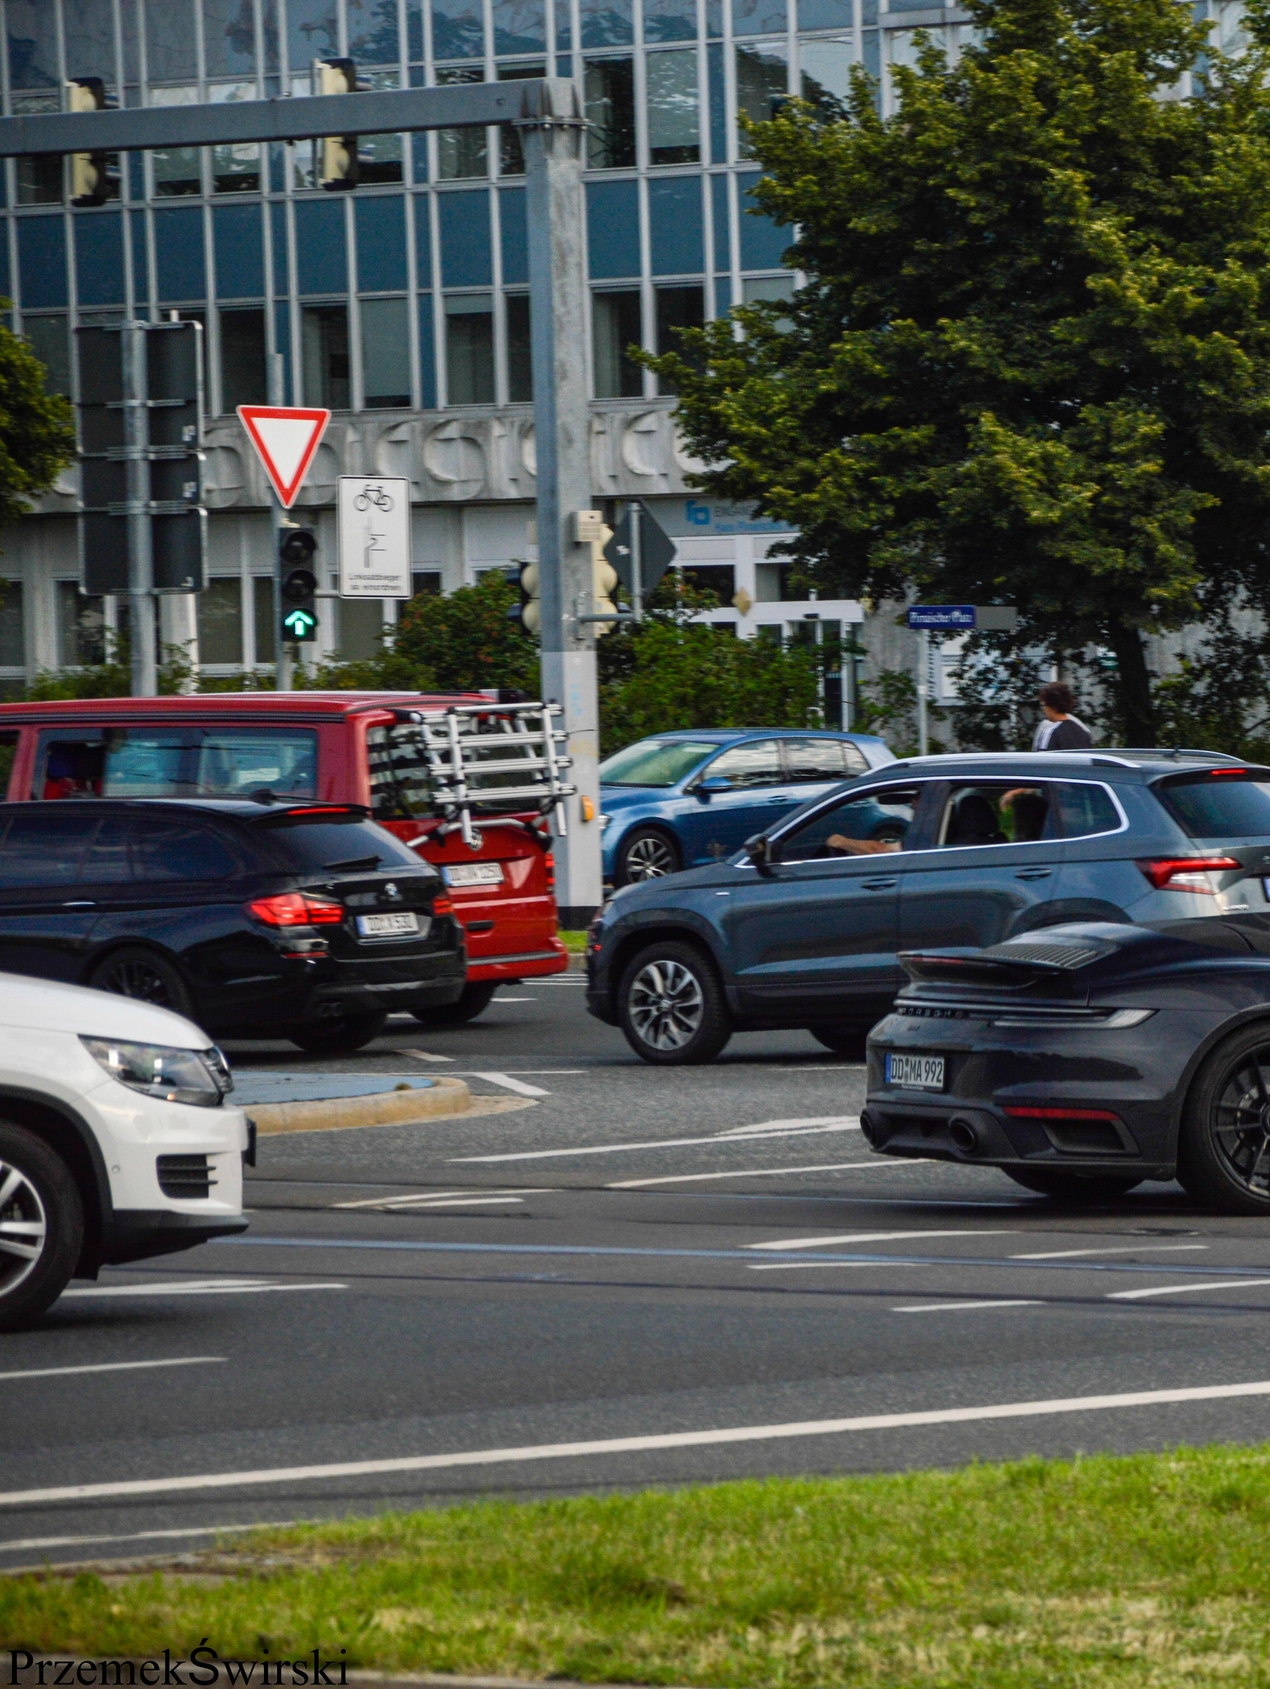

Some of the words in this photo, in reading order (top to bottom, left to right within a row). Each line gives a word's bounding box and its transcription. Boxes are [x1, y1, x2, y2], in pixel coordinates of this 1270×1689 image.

[898, 1007, 964, 1018] PORSCHE
[891, 1058, 904, 1080] DD
[910, 1059, 922, 1082] MA
[924, 1060, 943, 1083] 992
